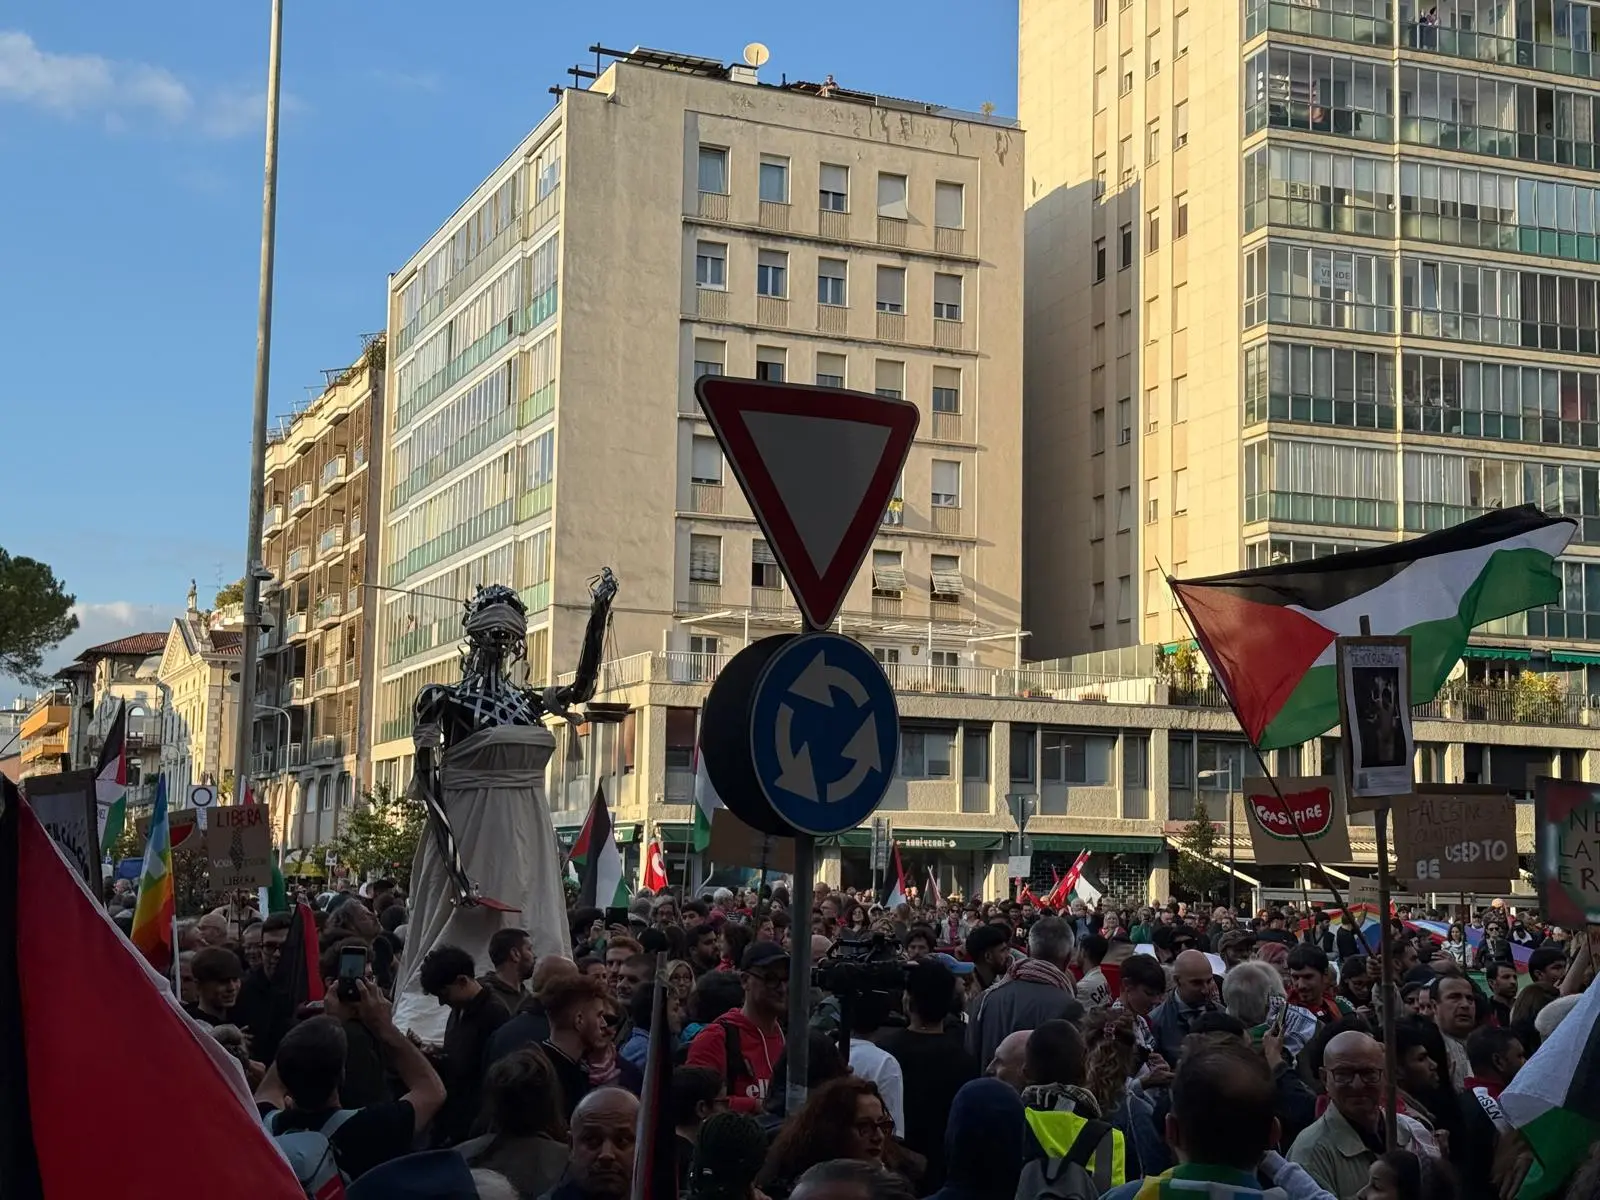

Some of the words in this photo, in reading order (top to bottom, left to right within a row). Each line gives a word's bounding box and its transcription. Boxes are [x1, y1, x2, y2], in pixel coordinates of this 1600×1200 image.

[217, 808, 263, 829] LIBERA
[1444, 841, 1481, 863] USED
[1481, 839, 1508, 862] TO
[1416, 858, 1441, 880] BE
